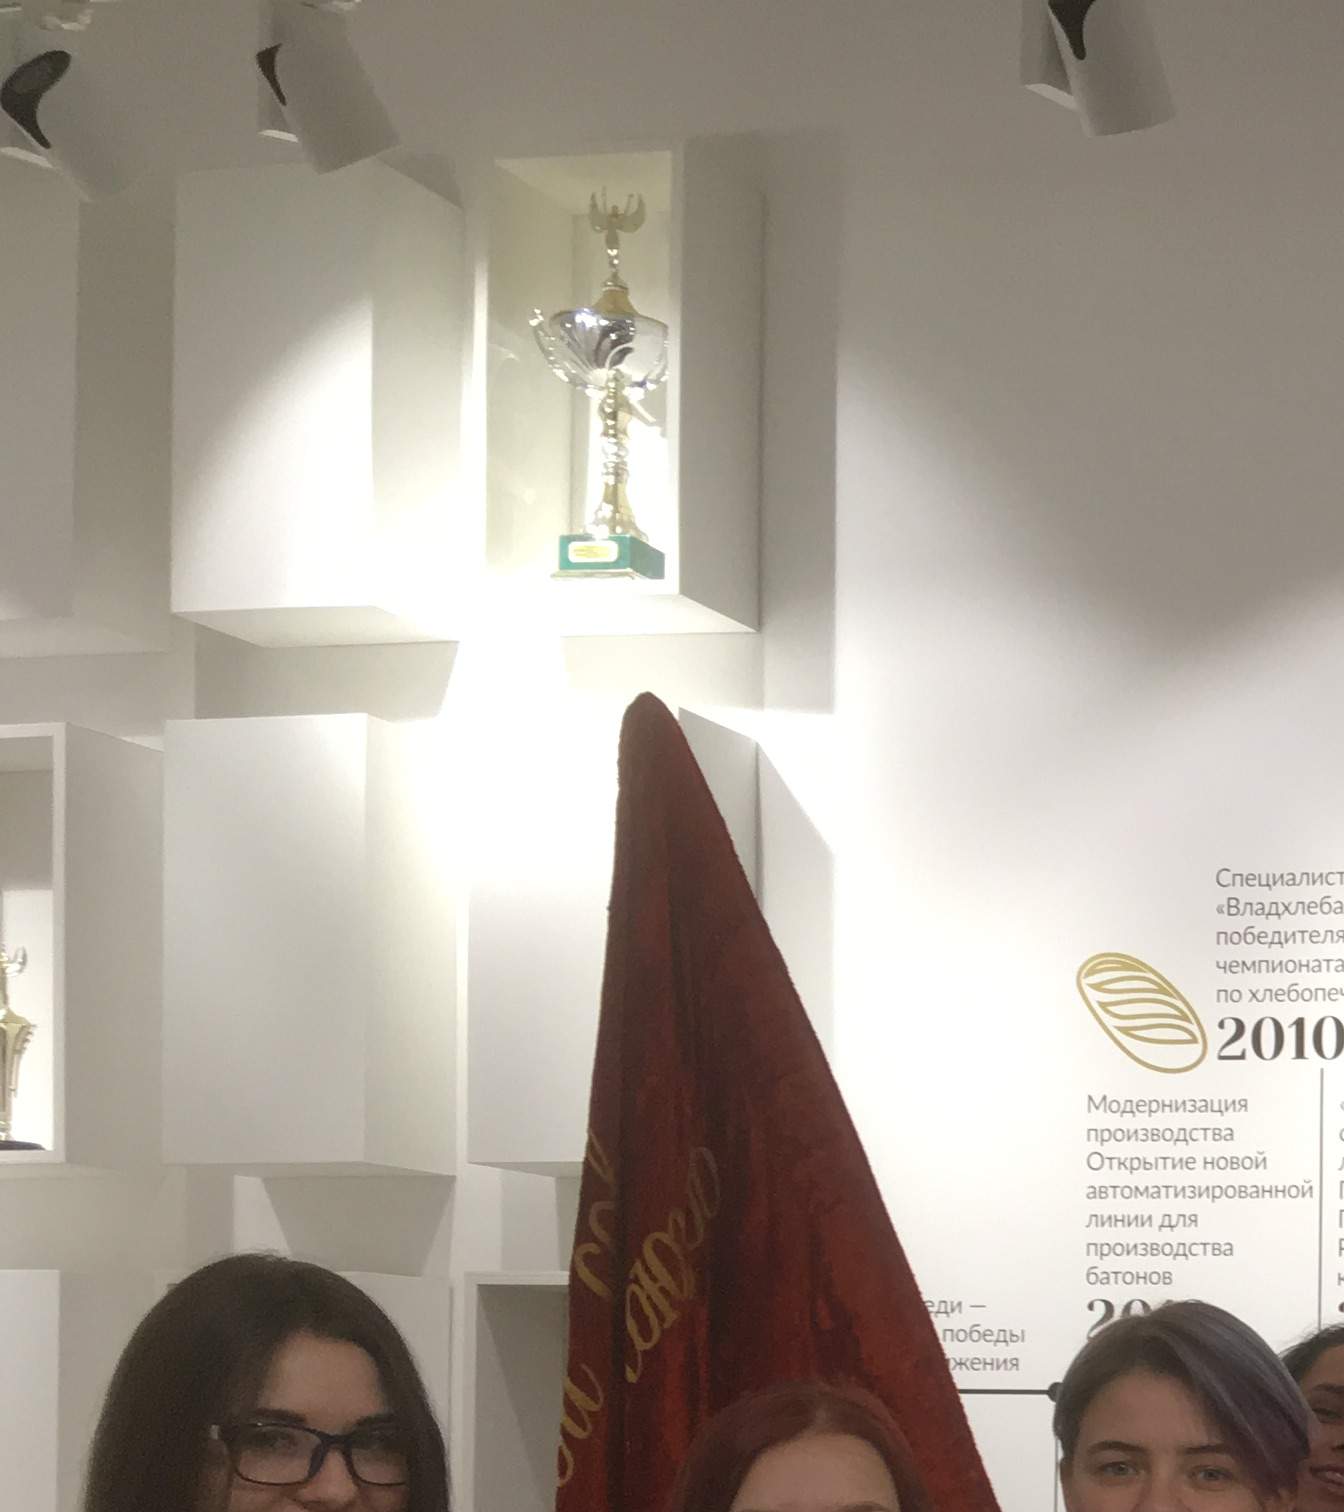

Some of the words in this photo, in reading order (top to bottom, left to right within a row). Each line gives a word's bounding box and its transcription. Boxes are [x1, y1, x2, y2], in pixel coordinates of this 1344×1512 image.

[1087, 1092, 1249, 1119] Модернизация
[1086, 1126, 1235, 1148] производства
[1086, 1150, 1197, 1176] Открытие
[1202, 1150, 1268, 1172] новой
[1085, 1178, 1314, 1205] автоматизированной
[1085, 1265, 1174, 1287] батонов
[941, 1322, 1027, 1348] победы
